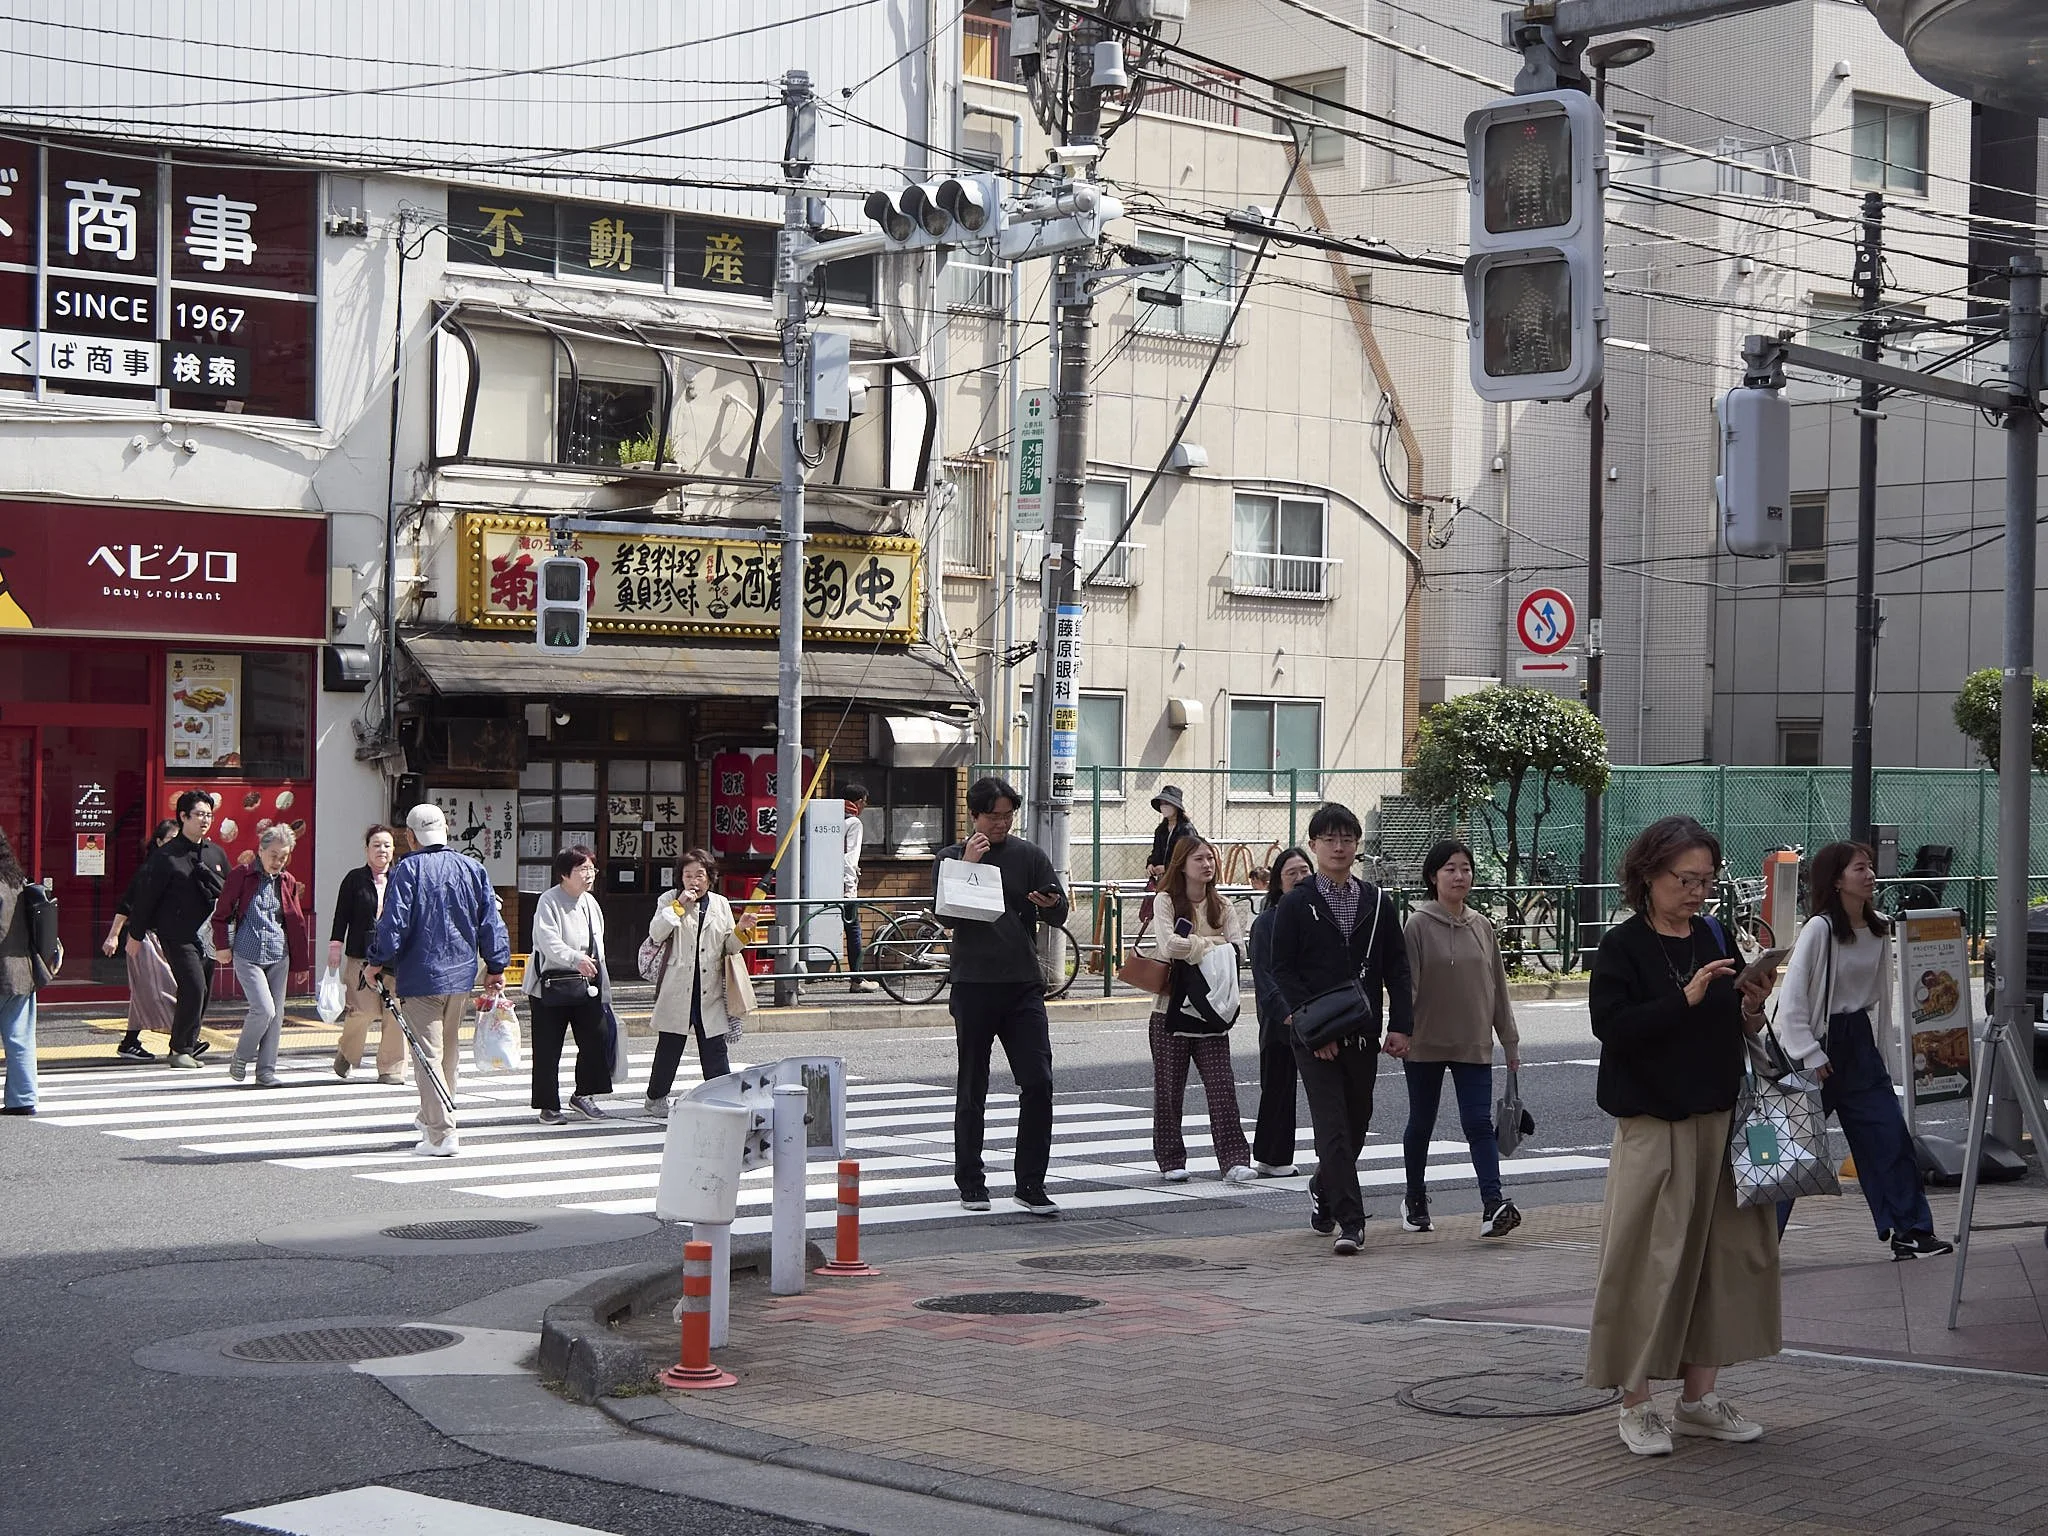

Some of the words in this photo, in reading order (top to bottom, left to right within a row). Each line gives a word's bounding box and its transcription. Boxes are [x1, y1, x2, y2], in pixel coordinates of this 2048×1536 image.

[476, 206, 745, 285] 不動産
[55, 291, 149, 324] SINCE
[176, 302, 246, 333] 1967
[11, 340, 150, 377] くば商事
[172, 351, 237, 387] 検索
[1020, 456, 1028, 491] クリニック
[1026, 444, 1036, 491] メンタル
[87, 543, 238, 584] ベビクロ
[518, 535, 584, 553] 灘の生本
[103, 585, 140, 599] Baby
[146, 588, 222, 601] croissant
[1055, 618, 1074, 700] 藤原眼科
[503, 801, 513, 840] ふる里の
[813, 824, 841, 834] 435-03
